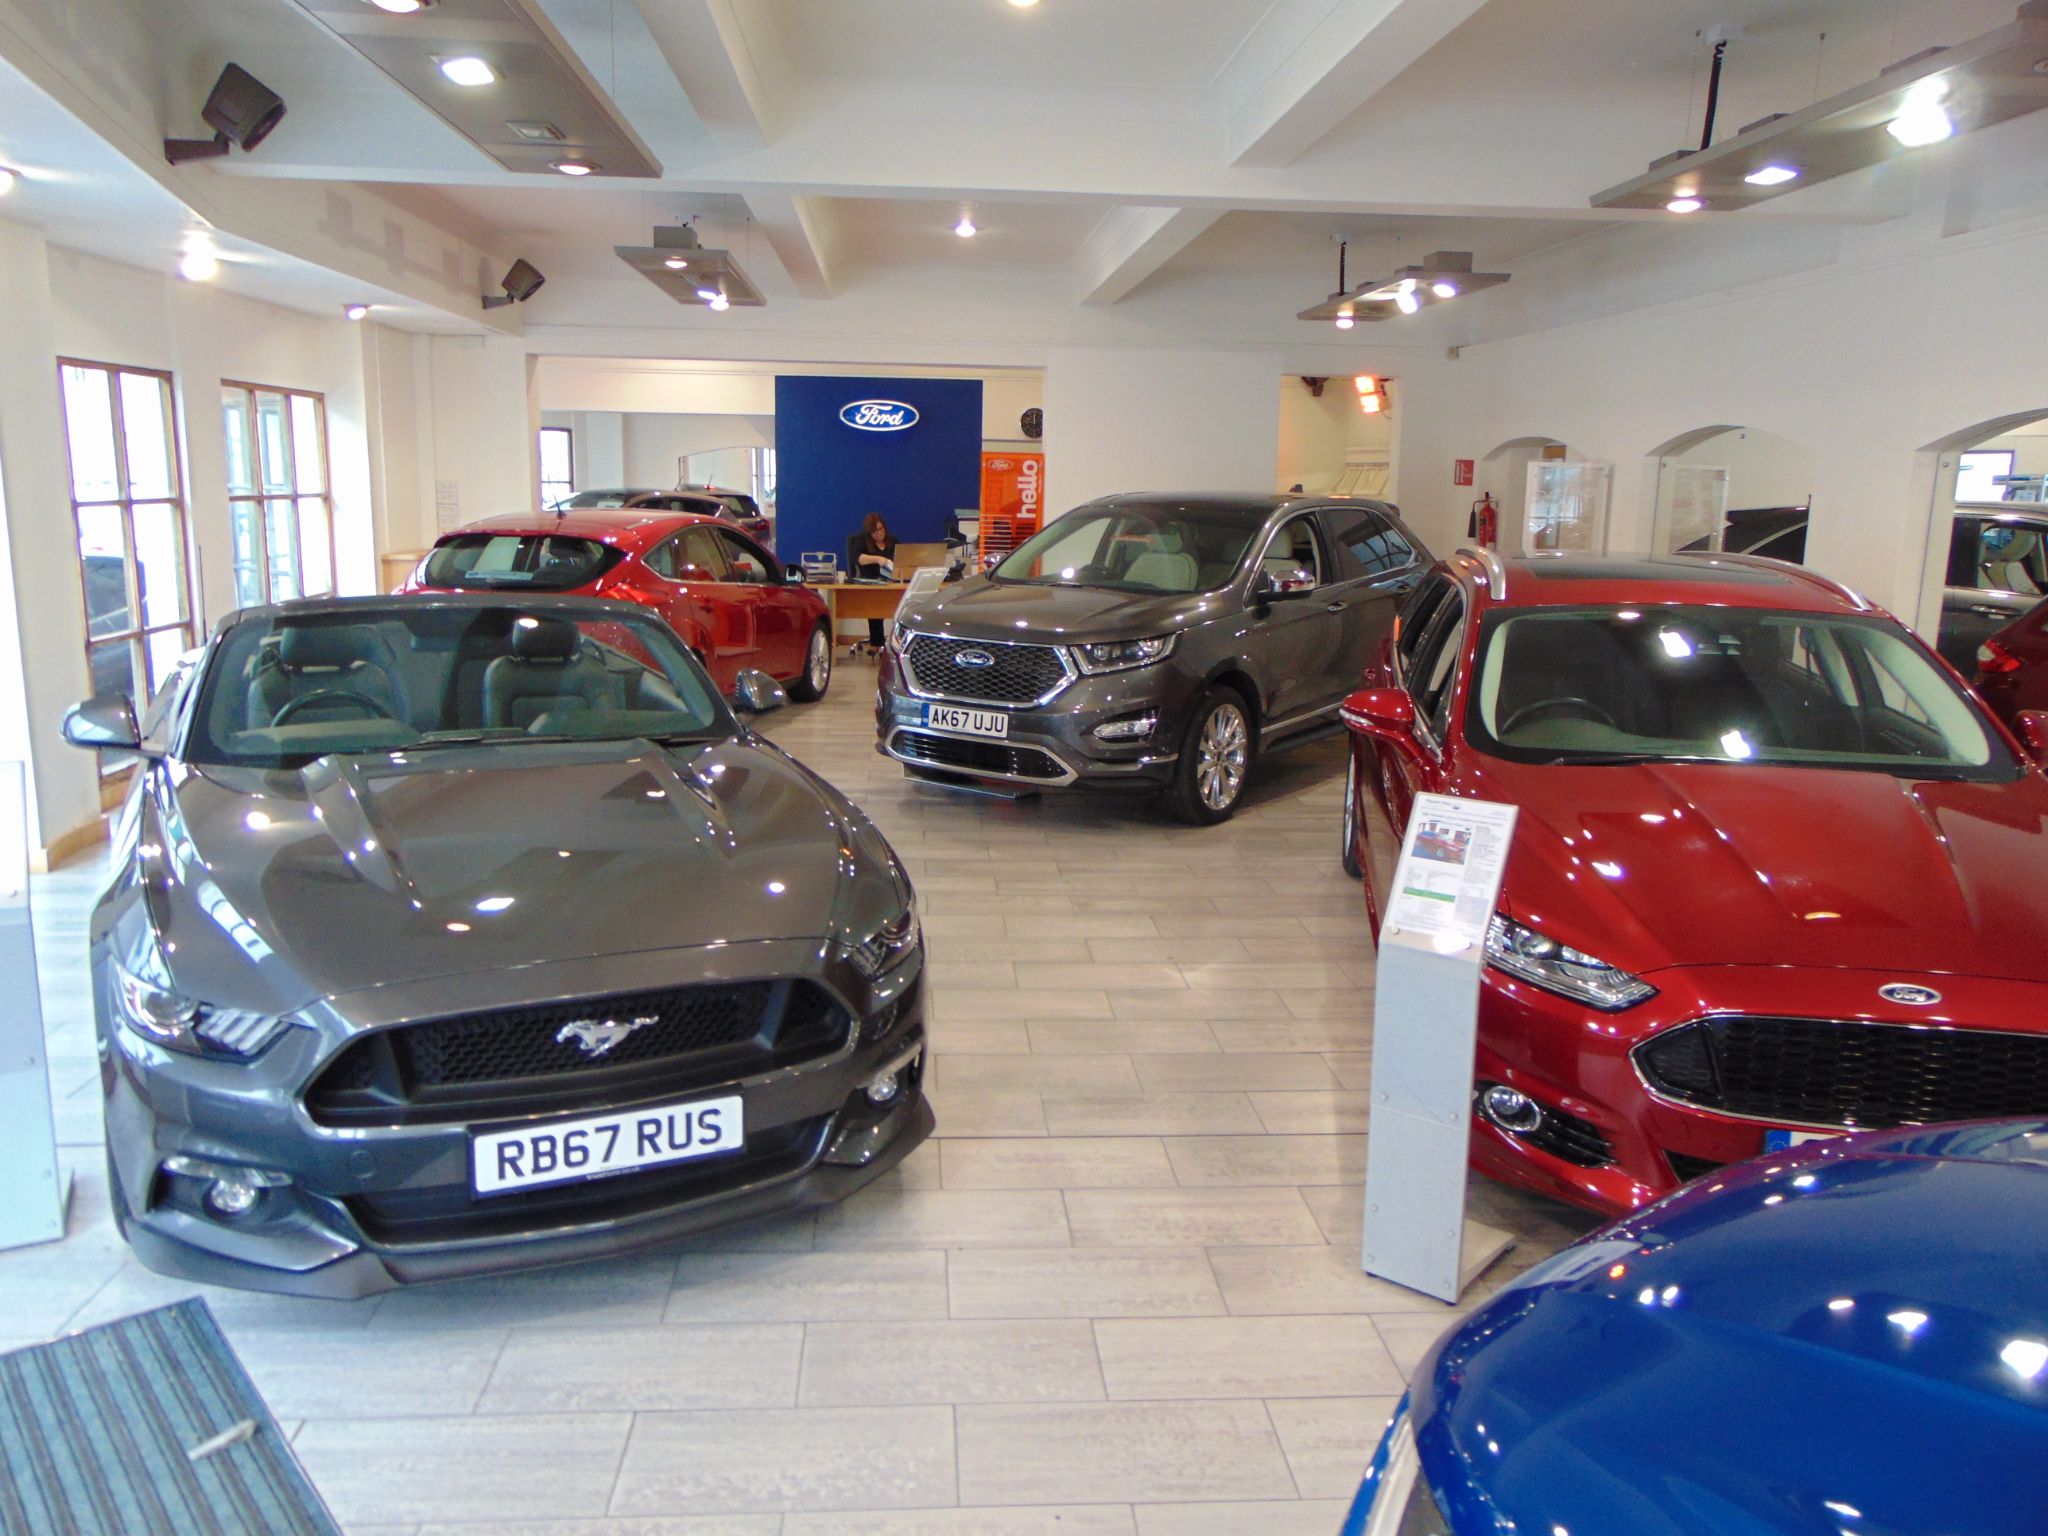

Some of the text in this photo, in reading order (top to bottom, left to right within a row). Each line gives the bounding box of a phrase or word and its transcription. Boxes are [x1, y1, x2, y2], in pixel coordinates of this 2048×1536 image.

[855, 404, 904, 425] Ford
[1016, 459, 1038, 518] hello
[931, 708, 1005, 733] AK67 UJU
[1892, 987, 1926, 1002] Ford
[497, 1107, 722, 1181] RB67 RUS
